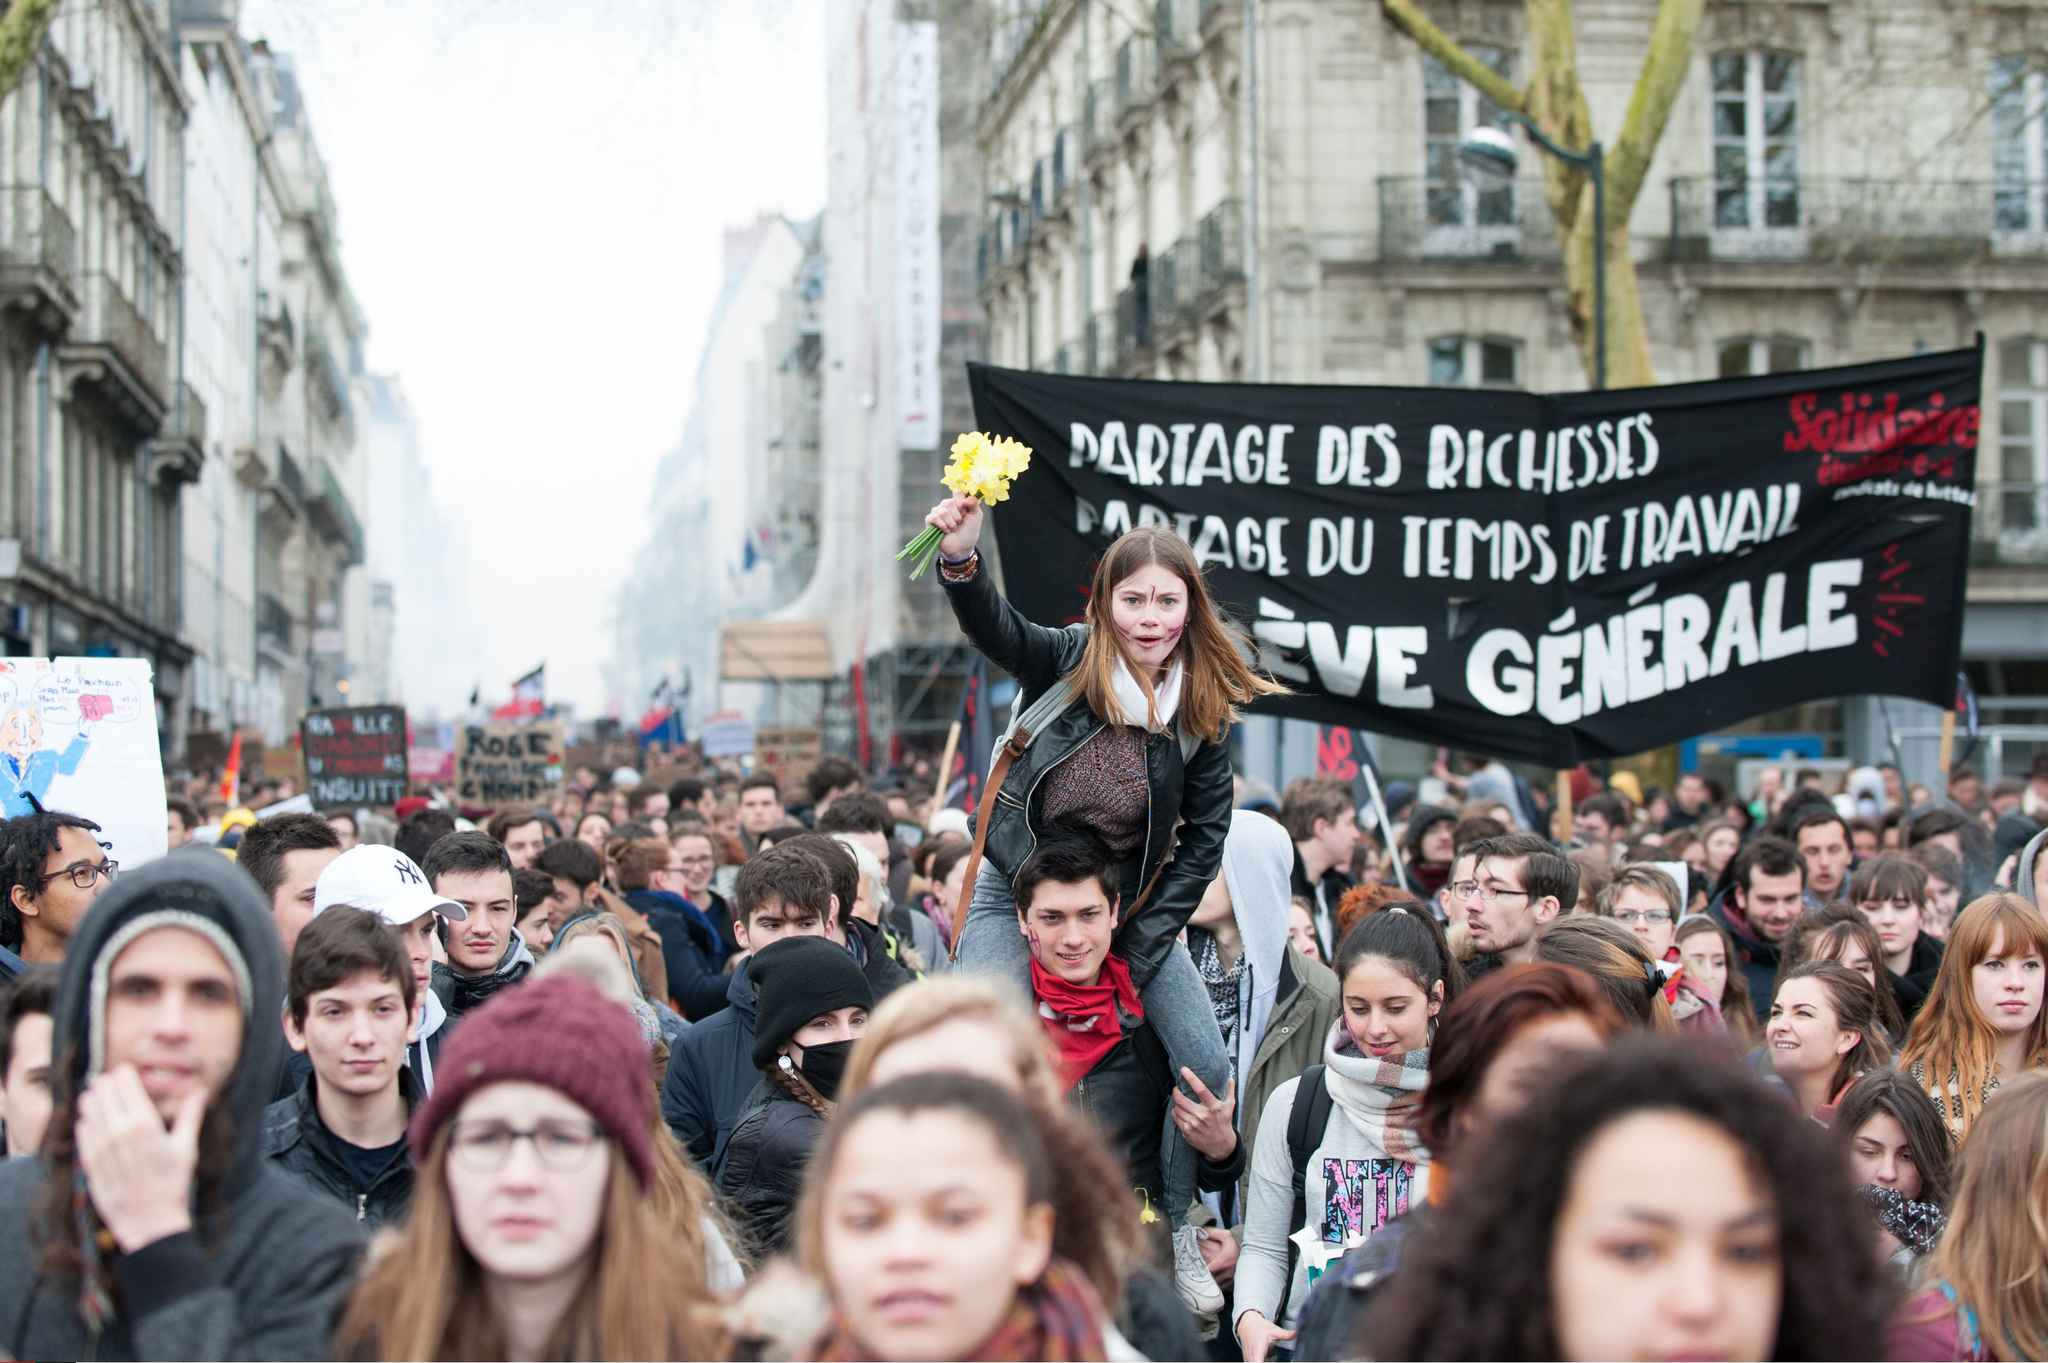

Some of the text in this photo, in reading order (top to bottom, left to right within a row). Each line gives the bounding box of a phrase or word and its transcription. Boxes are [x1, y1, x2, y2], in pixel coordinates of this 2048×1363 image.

[1069, 412, 1660, 495] PARTAGE DES RICHESSES
[1306, 516, 1375, 577] DU
[1402, 515, 1558, 585] TEMPS
[1568, 514, 1612, 582] DE
[1619, 482, 1801, 571] TRAVAIL
[1240, 558, 1864, 725] ÈVE GÉNÉRALE
